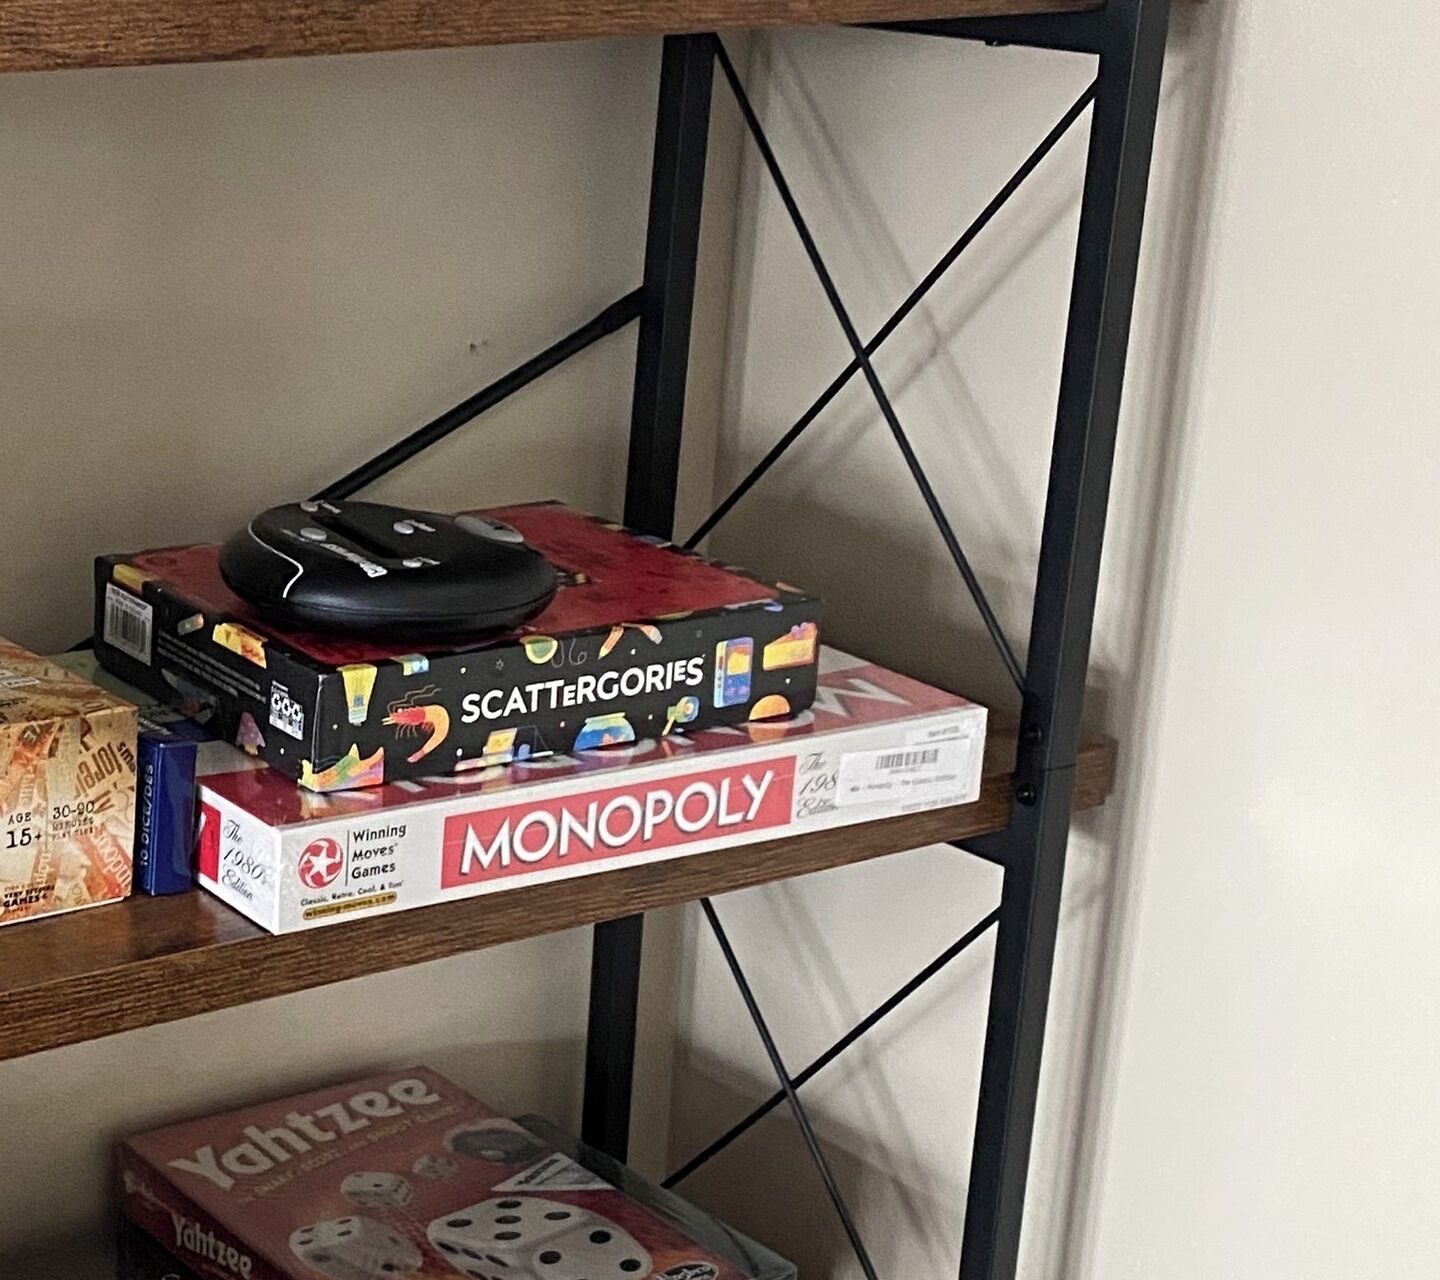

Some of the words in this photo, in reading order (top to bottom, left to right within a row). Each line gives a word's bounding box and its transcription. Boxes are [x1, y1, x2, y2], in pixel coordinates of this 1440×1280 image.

[460, 653, 705, 724] SCATTERGORIES
[8, 812, 32, 826] AGE
[459, 768, 777, 877] MONOPOLY
[6, 828, 43, 850] 15+
[352, 823, 407, 843] Winning
[351, 844, 398, 862] Moves
[351, 862, 396, 880] Games
[167, 1077, 443, 1193] Yahtzee
